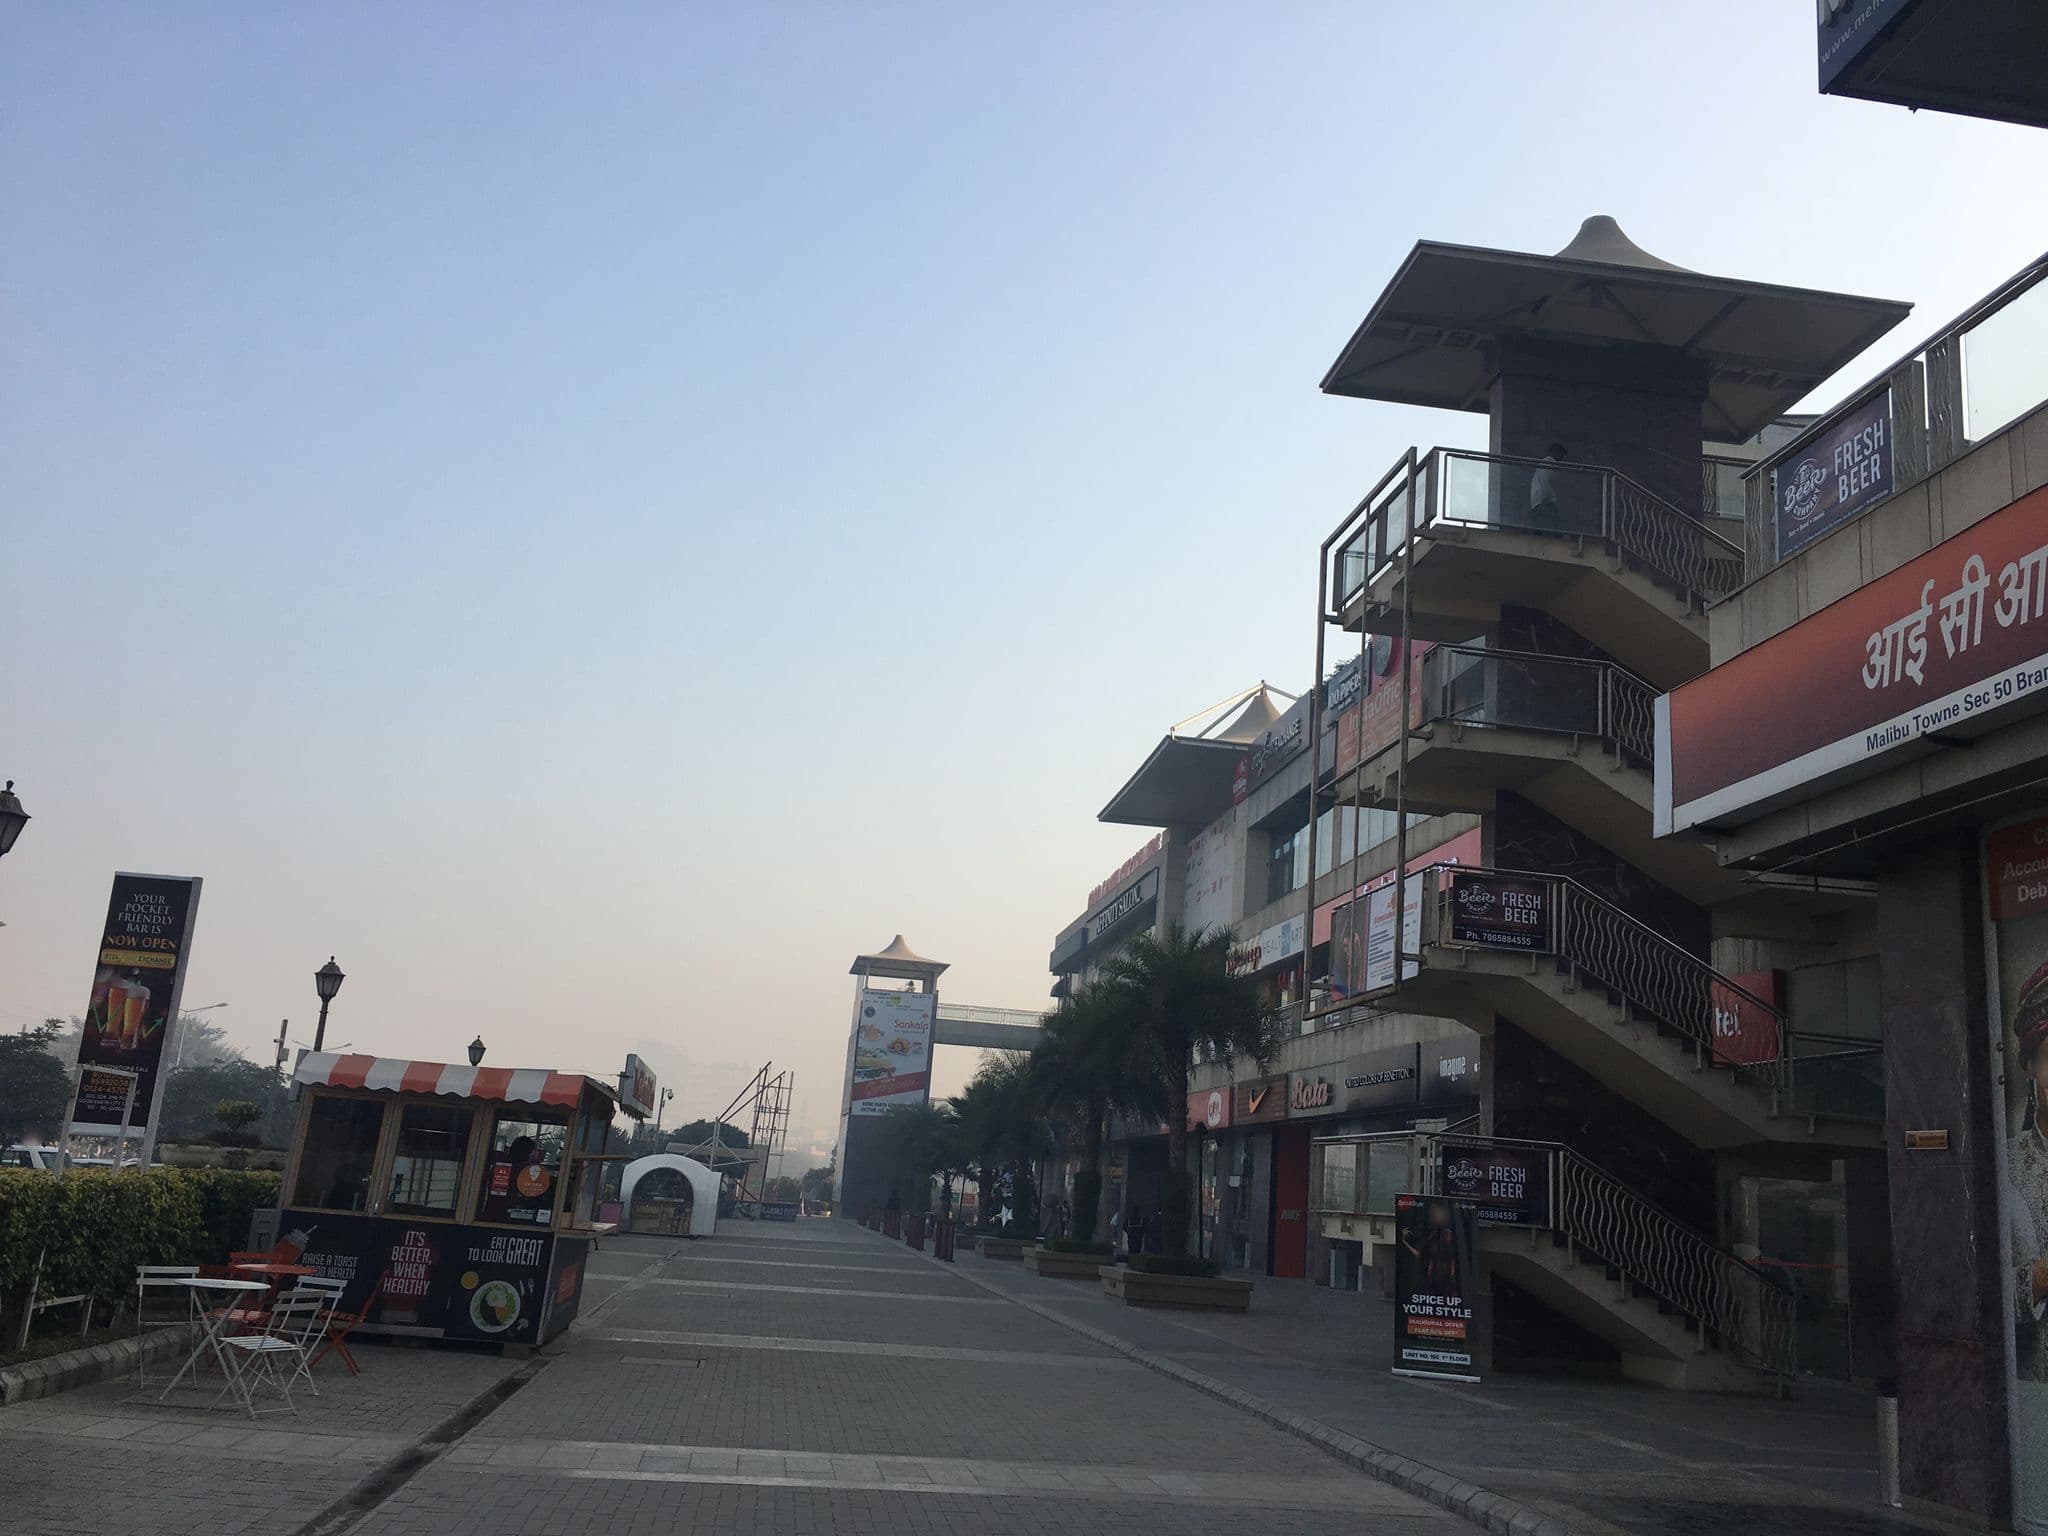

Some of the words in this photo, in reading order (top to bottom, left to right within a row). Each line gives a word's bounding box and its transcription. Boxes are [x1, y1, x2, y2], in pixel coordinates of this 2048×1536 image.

[1834, 418, 1884, 475] FRESH
[1838, 454, 1881, 503] BEER
[1862, 579, 1935, 689] आई
[1939, 554, 1990, 659] सी
[1867, 720, 1910, 751] Malibu
[1913, 702, 1960, 732] Towne
[1964, 692, 1990, 713] Sec
[1994, 678, 2012, 701] 50
[133, 893, 166, 905] YOUR
[1502, 891, 1541, 909] FRESH
[125, 903, 169, 916] POCKET
[1504, 907, 1538, 925] BEER
[118, 912, 175, 926] FRIENDLY
[127, 923, 149, 934] BAR
[151, 925, 161, 934] IS
[106, 935, 137, 947] NOW
[142, 937, 176, 949] OPEN
[1439, 1056, 1466, 1081] imagine
[1292, 1077, 1330, 1110] Bata
[1488, 1165, 1527, 1184] FRESH
[1491, 1181, 1524, 1200] BEER
[404, 1230, 426, 1247] IT'S
[491, 1236, 509, 1250] EAT
[302, 1252, 325, 1266] RAISE
[325, 1254, 332, 1266] A
[334, 1255, 358, 1268] TOAST
[391, 1246, 432, 1266] BETTER,
[468, 1247, 480, 1261] TO
[480, 1248, 505, 1264] LOOK
[506, 1237, 544, 1266] GREAT
[327, 1266, 356, 1280] HEALTH
[394, 1261, 427, 1279] WHEN
[382, 1277, 431, 1296] HEALTHY
[1411, 1294, 1444, 1305] SPICE
[1446, 1296, 1462, 1307] UP
[1402, 1304, 1433, 1315] YOUR
[1435, 1306, 1472, 1318] STYLE
[1449, 1355, 1469, 1363] FLOOR
